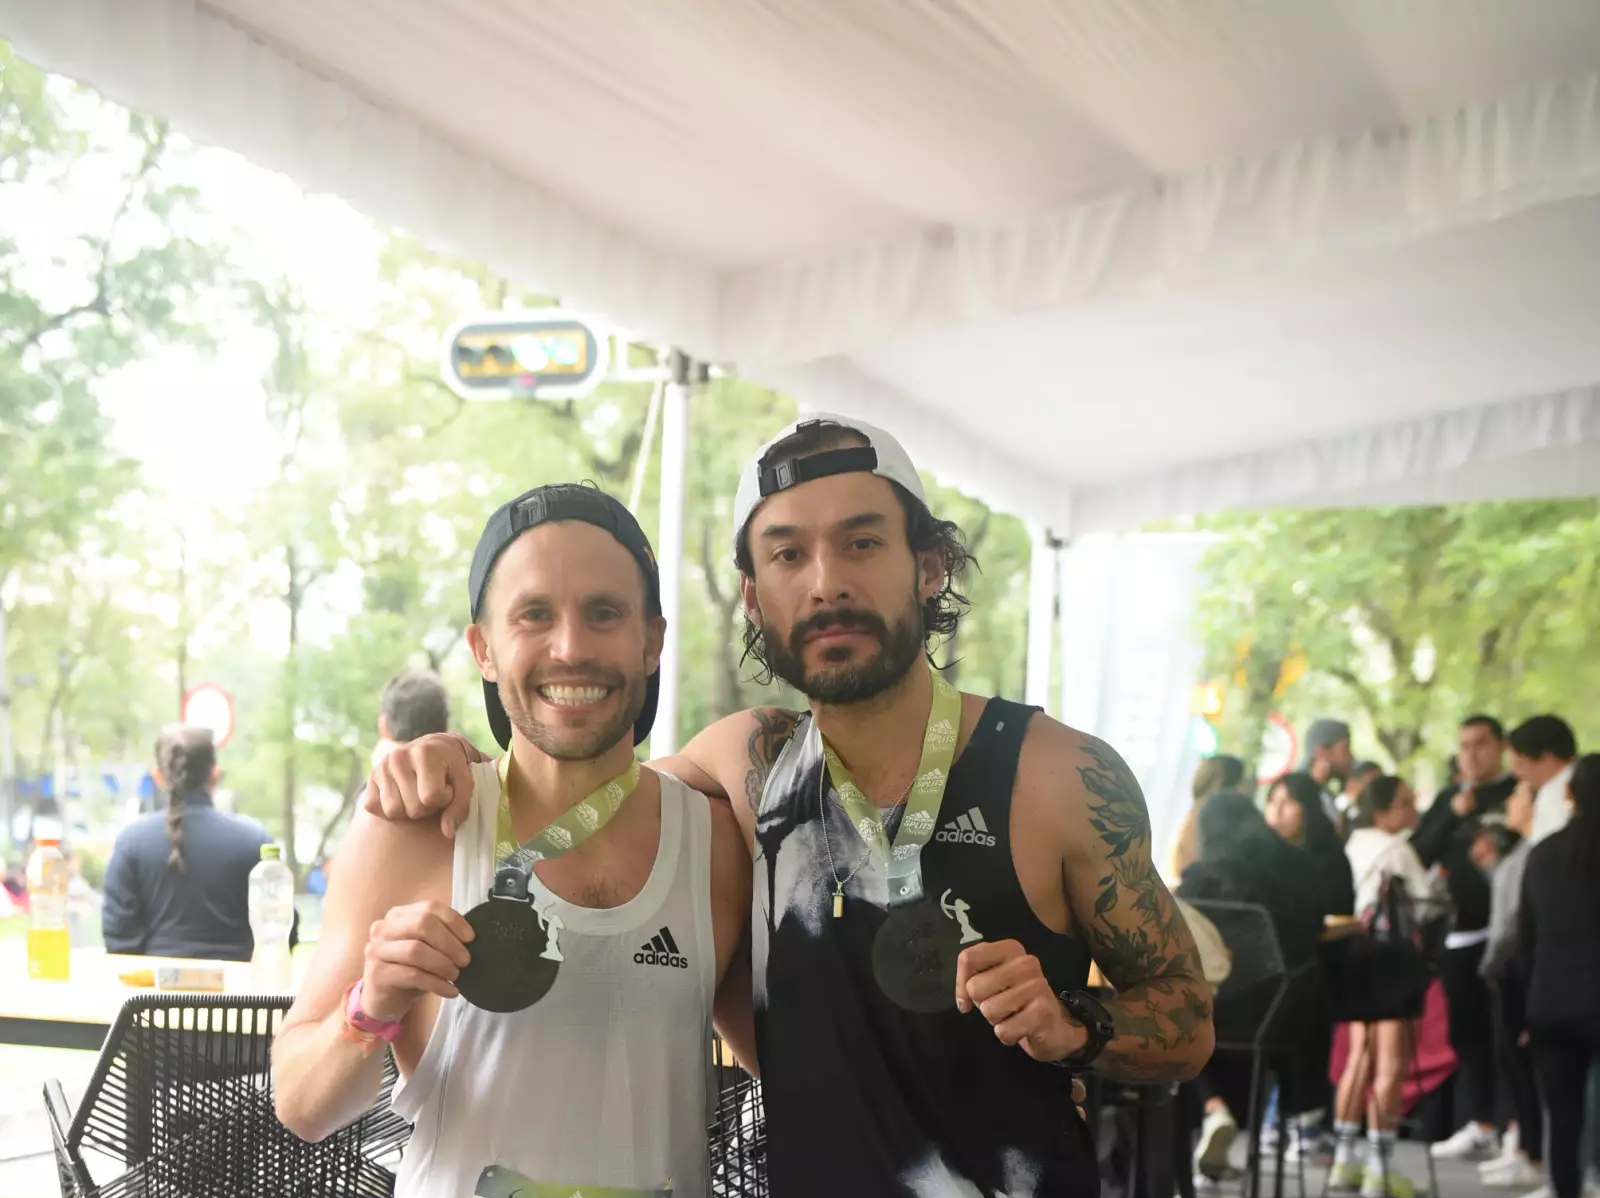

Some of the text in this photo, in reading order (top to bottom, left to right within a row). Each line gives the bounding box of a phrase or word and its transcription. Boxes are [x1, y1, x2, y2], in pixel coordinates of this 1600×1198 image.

[916, 779, 945, 788] SPLITS
[903, 819, 934, 831] SPLITS
[935, 828, 996, 847] adidas
[633, 950, 688, 969] adidas
